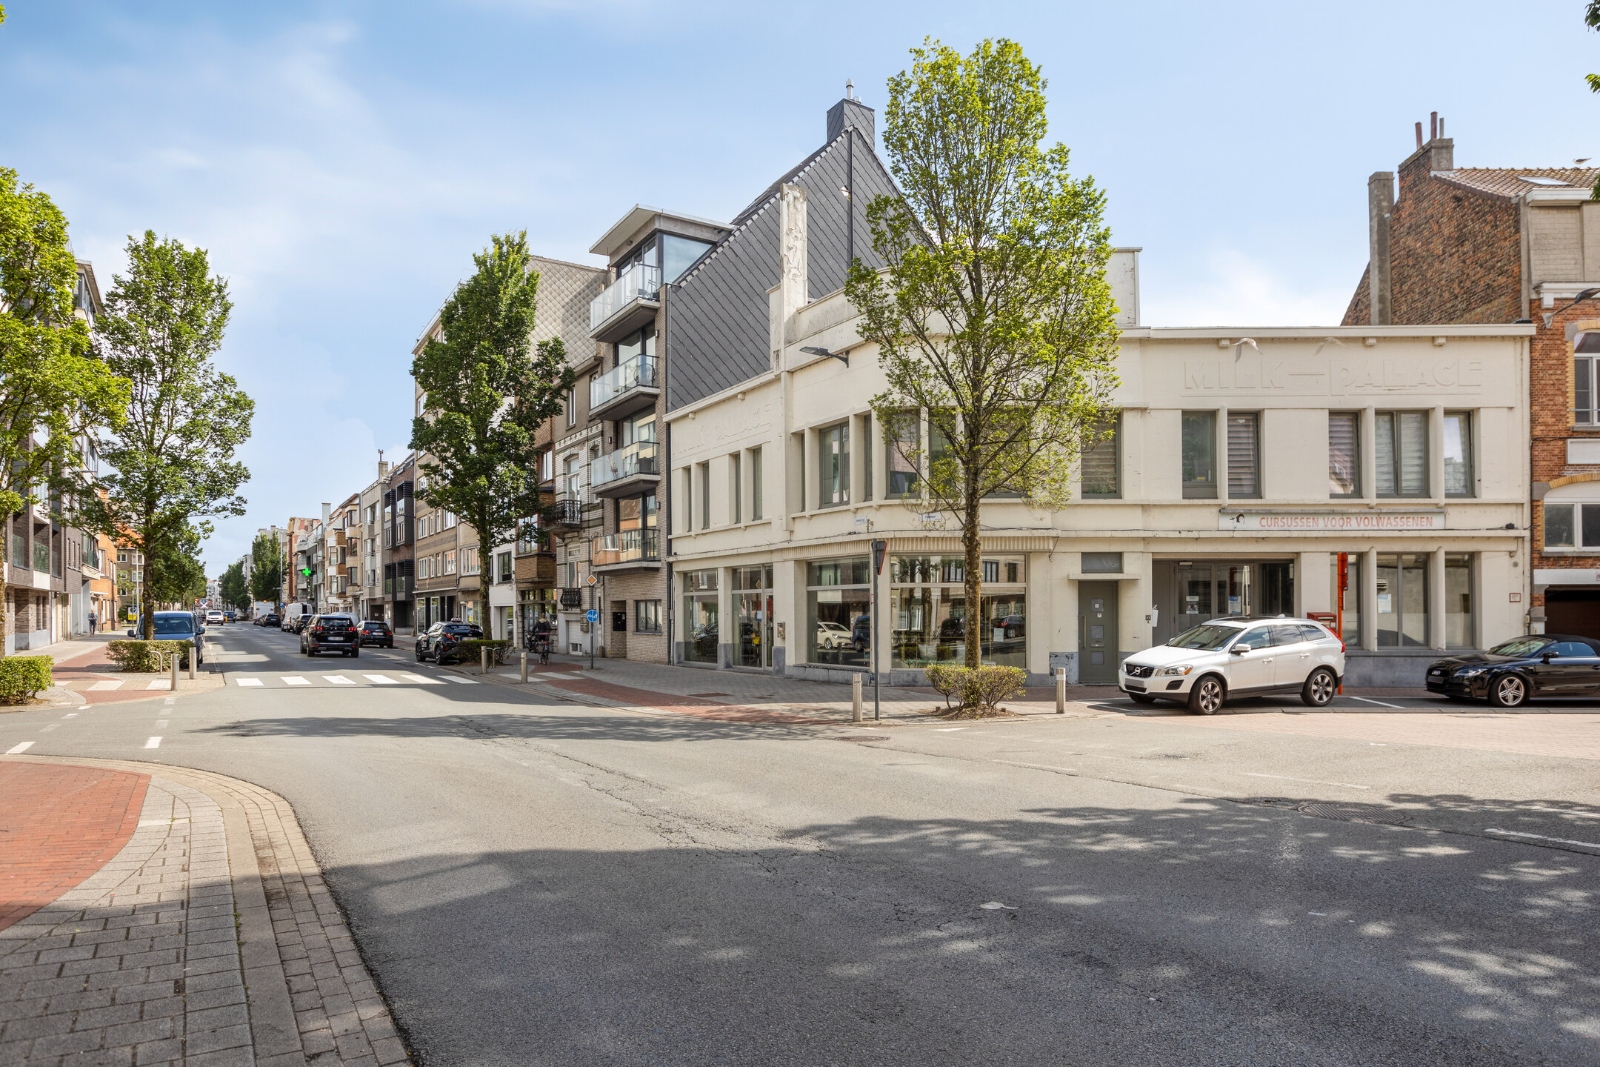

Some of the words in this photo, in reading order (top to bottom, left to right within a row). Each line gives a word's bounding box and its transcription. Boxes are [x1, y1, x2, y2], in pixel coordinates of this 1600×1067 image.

[1259, 516, 1319, 528] CURSUSSEN
[1322, 516, 1353, 528] VOOR
[1355, 515, 1433, 528] VOLWASSENEN
